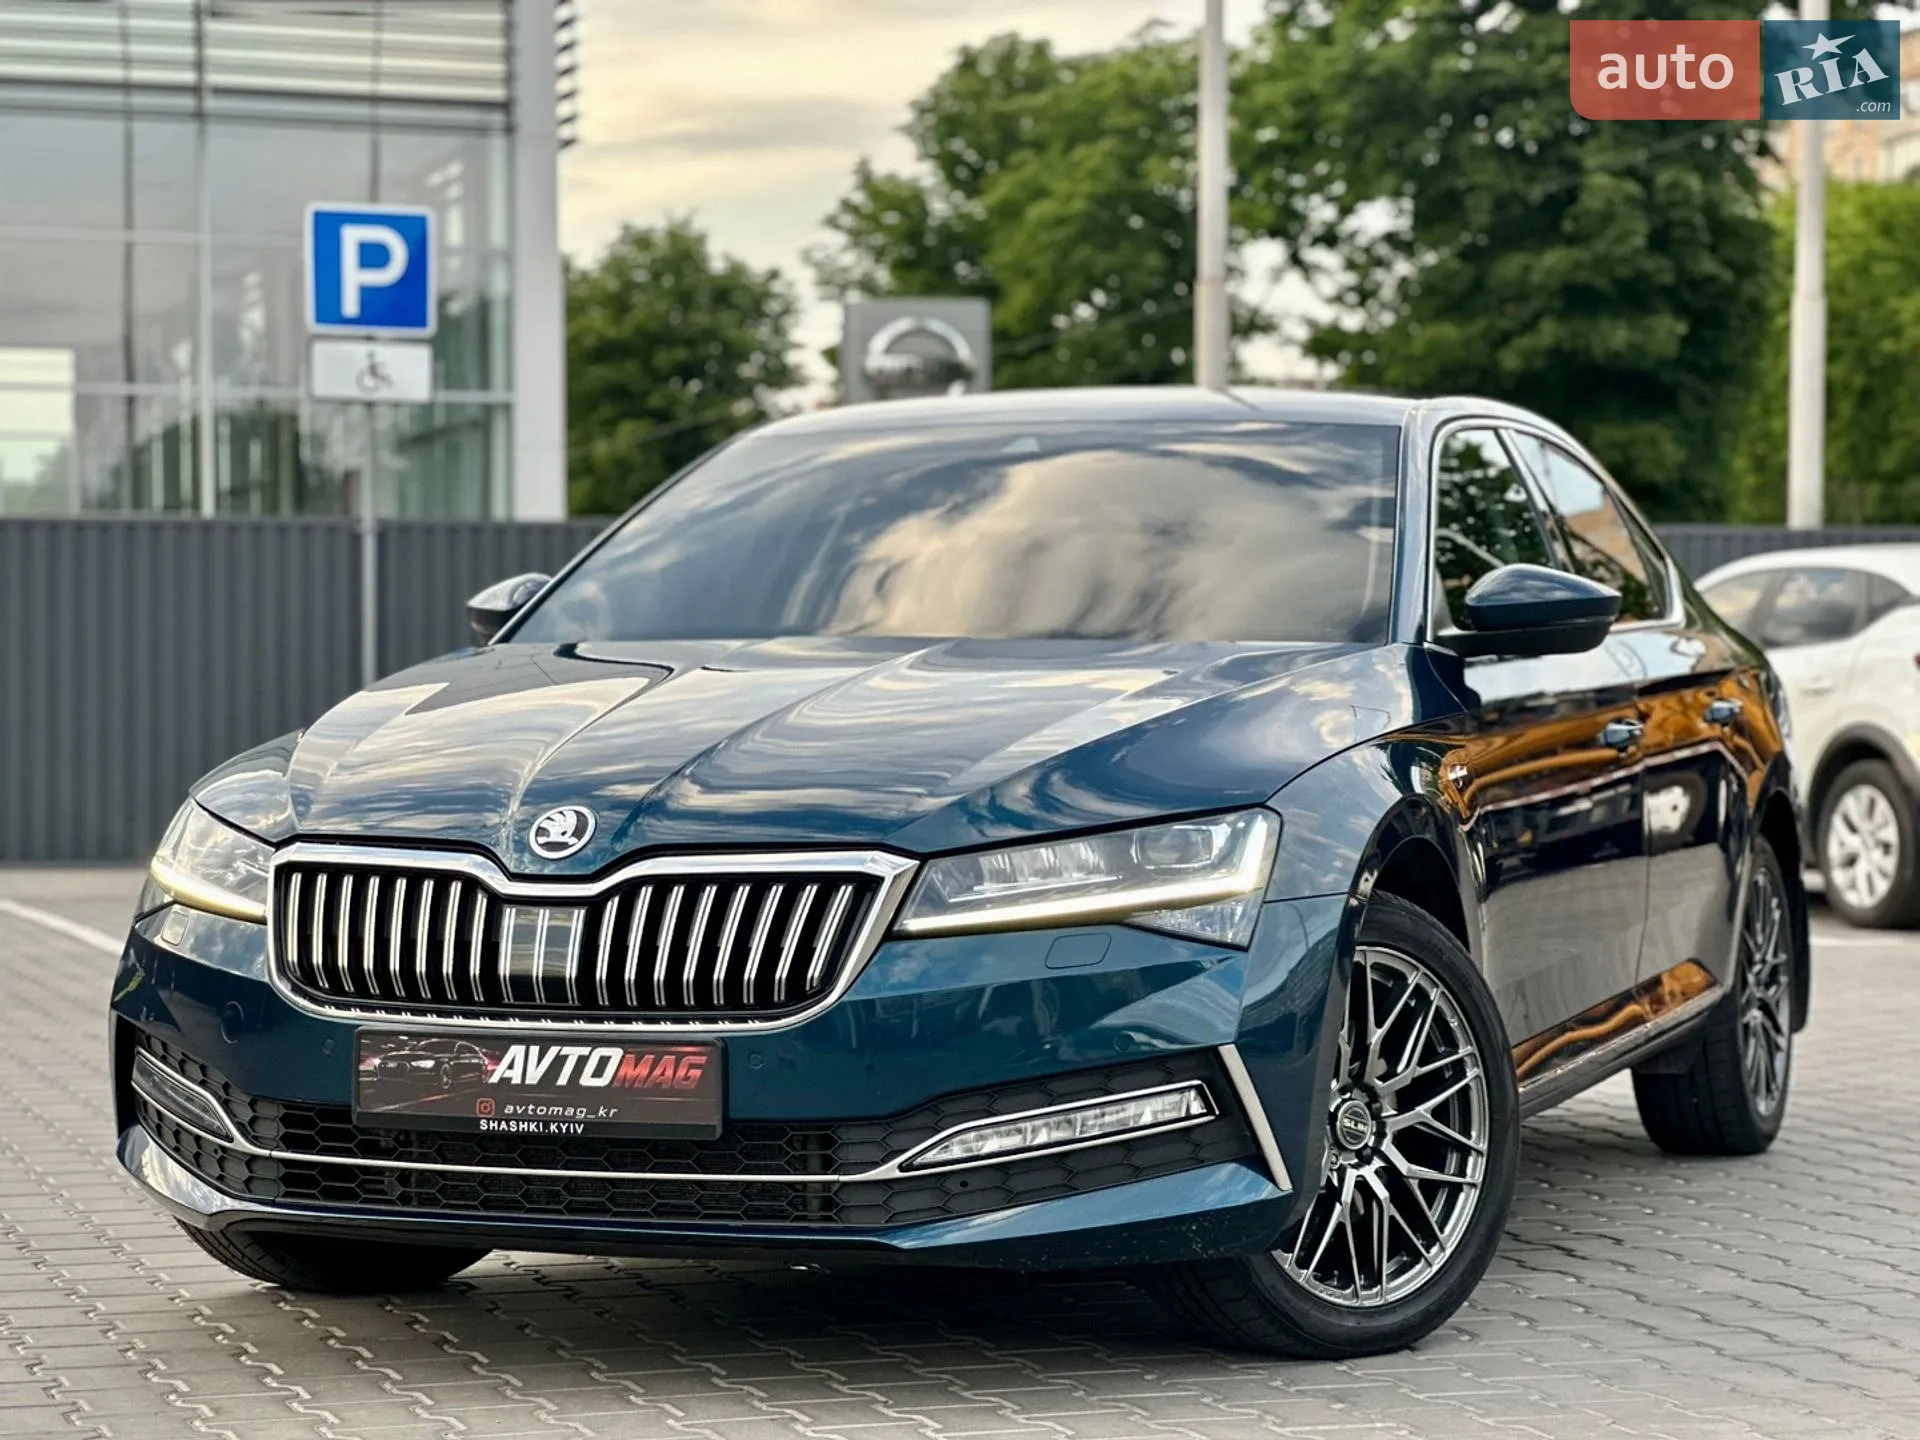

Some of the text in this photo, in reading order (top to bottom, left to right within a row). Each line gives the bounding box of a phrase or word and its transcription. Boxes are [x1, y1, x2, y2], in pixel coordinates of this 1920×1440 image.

[340, 223, 409, 319] P
[488, 1045, 708, 1089] AVTOMAG
[503, 1103, 618, 1119] avtomag_kr
[479, 1119, 584, 1134] SHASHKI.KYIV
